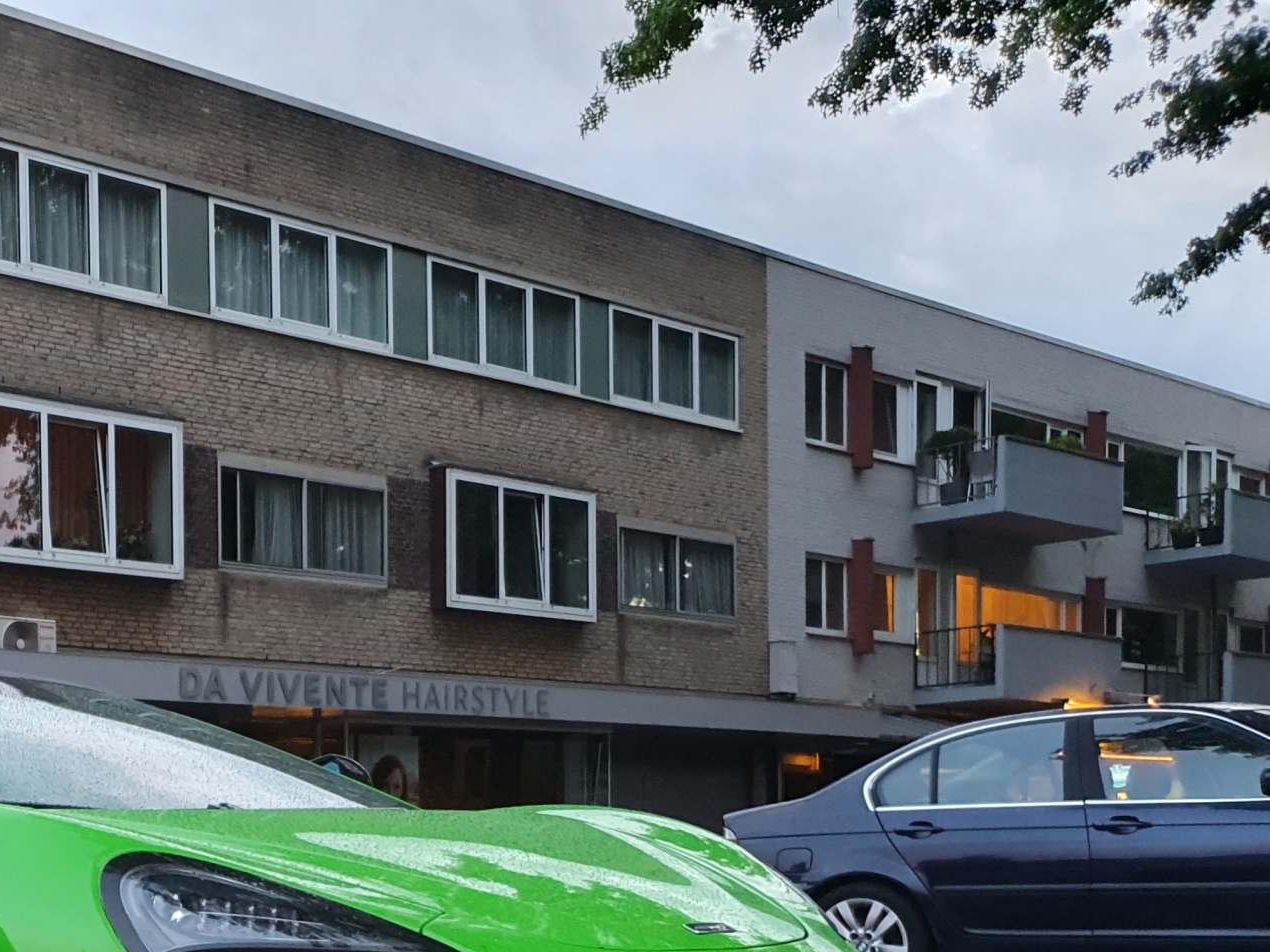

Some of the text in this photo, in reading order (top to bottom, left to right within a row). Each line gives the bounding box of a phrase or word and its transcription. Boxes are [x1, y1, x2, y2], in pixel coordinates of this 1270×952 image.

[178, 667, 551, 718] DA VIVENTE HAIRSTYLE
